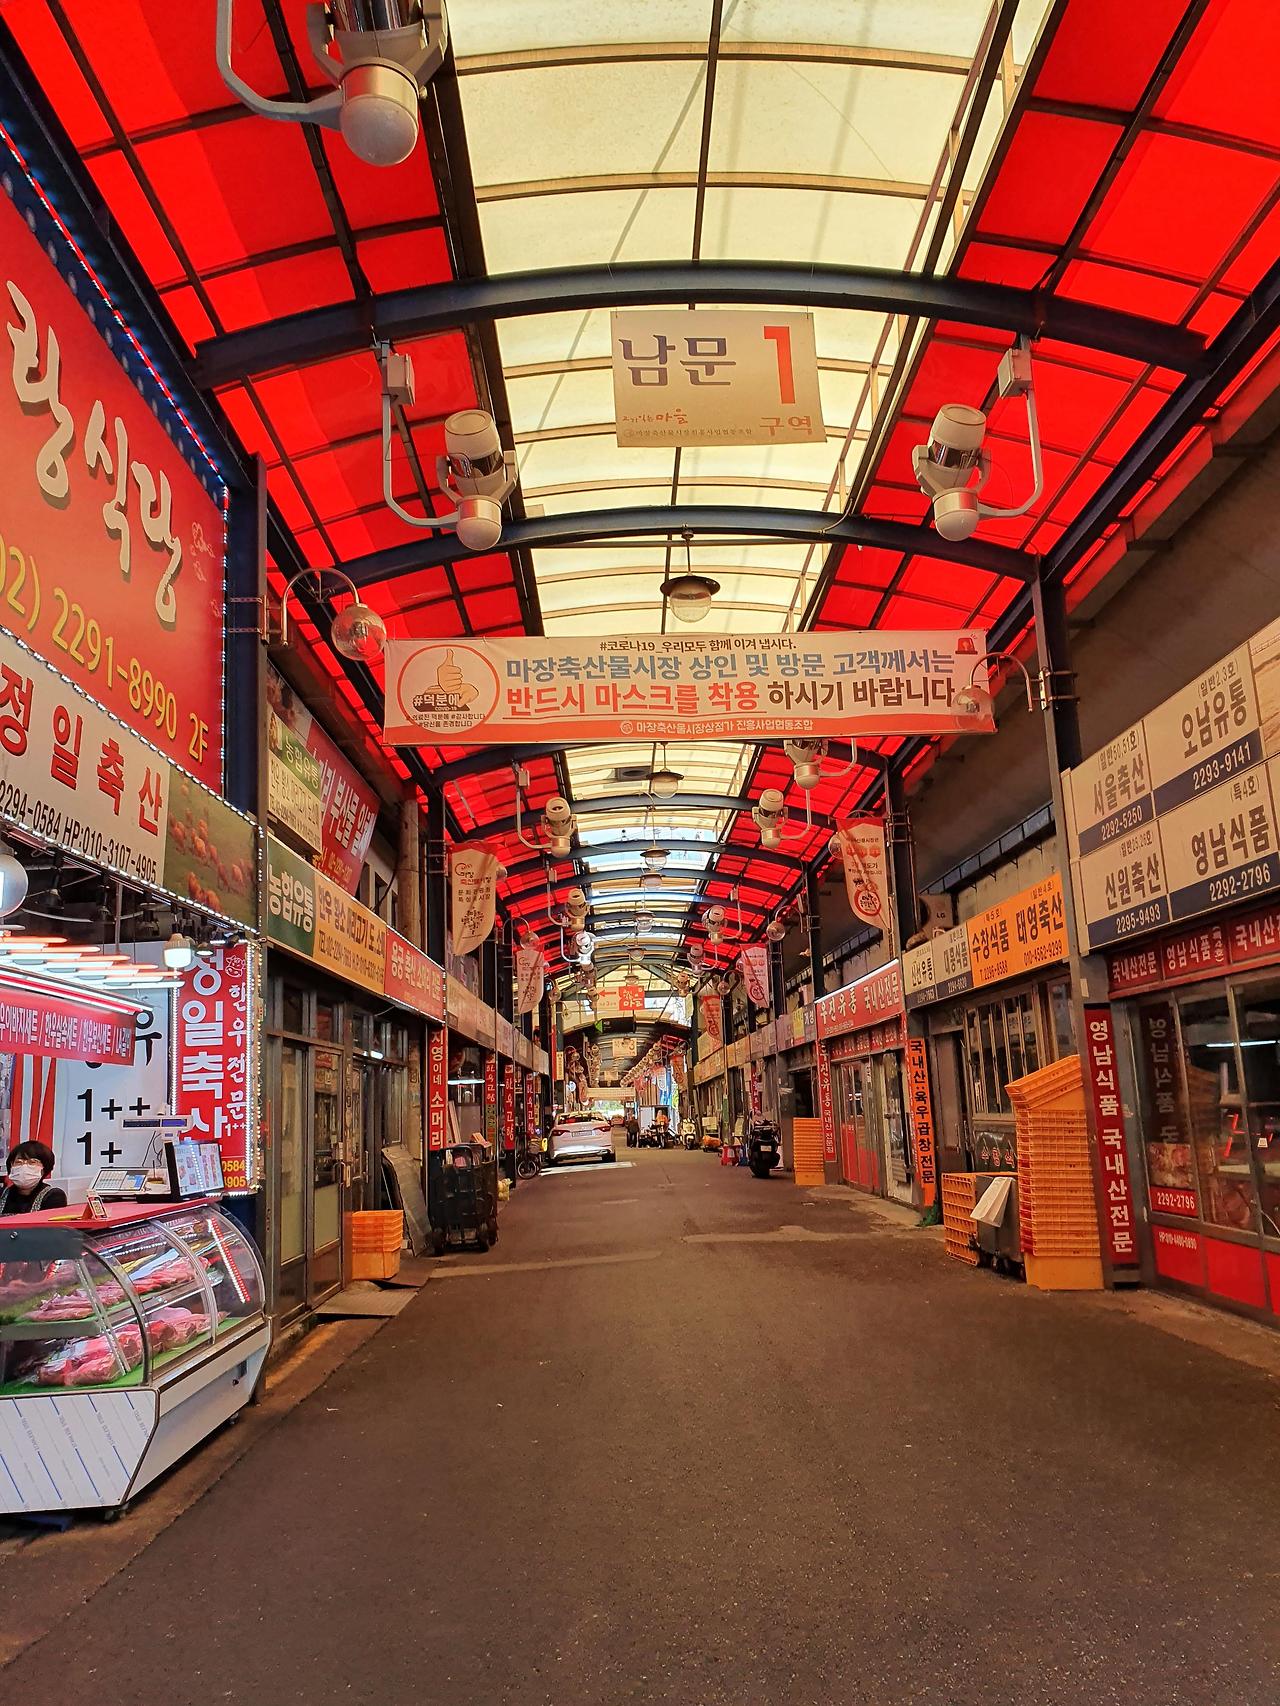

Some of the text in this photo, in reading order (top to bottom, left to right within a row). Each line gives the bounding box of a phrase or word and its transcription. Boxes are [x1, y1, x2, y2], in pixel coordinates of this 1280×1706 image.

[618, 326, 795, 404] 남문 1
[759, 415, 812, 436] 구역
[52, 586, 178, 741] 2291-8990
[189, 711, 209, 764] 2F
[507, 650, 955, 683] 마장축산물시장 상인 및 방문 고객께서는
[709, 639, 732, 650] 함께
[734, 638, 757, 650] 이겨
[759, 638, 797, 650] 냅시다.
[413, 694, 460, 706] #덕분에
[507, 676, 956, 716] 반드시 마스크를 착용 하시기 바랍니다
[735, 719, 813, 732] 진흥사업협동조합
[1181, 677, 1247, 759] 오남유통
[0, 662, 162, 837] 정일축산
[1193, 741, 1251, 791] 2293-9141
[1093, 752, 1146, 816] 서울축산
[62, 815, 157, 883] HP:010-3107-4905
[1101, 805, 1143, 841] 2292-5250
[1191, 804, 1271, 877] 영남식품
[269, 864, 314, 934] 농협유통
[1104, 852, 1161, 911] 신원축산
[1209, 863, 1271, 902] 2292-2796
[972, 891, 1064, 964] 수창식품 대영축산
[1112, 951, 1157, 984] 국내산전문
[1166, 932, 1211, 971] 영남식품
[1236, 914, 1280, 952] 국내산
[1116, 903, 1161, 935] 2295-9493
[180, 948, 226, 1151] 정일축산
[226, 982, 247, 1121] 한우전문
[430, 1030, 445, 1149] 지영이네 소머리
[1090, 1020, 1133, 1254] 영남식품 국내산전문
[1157, 1191, 1196, 1210] 2292-2796
